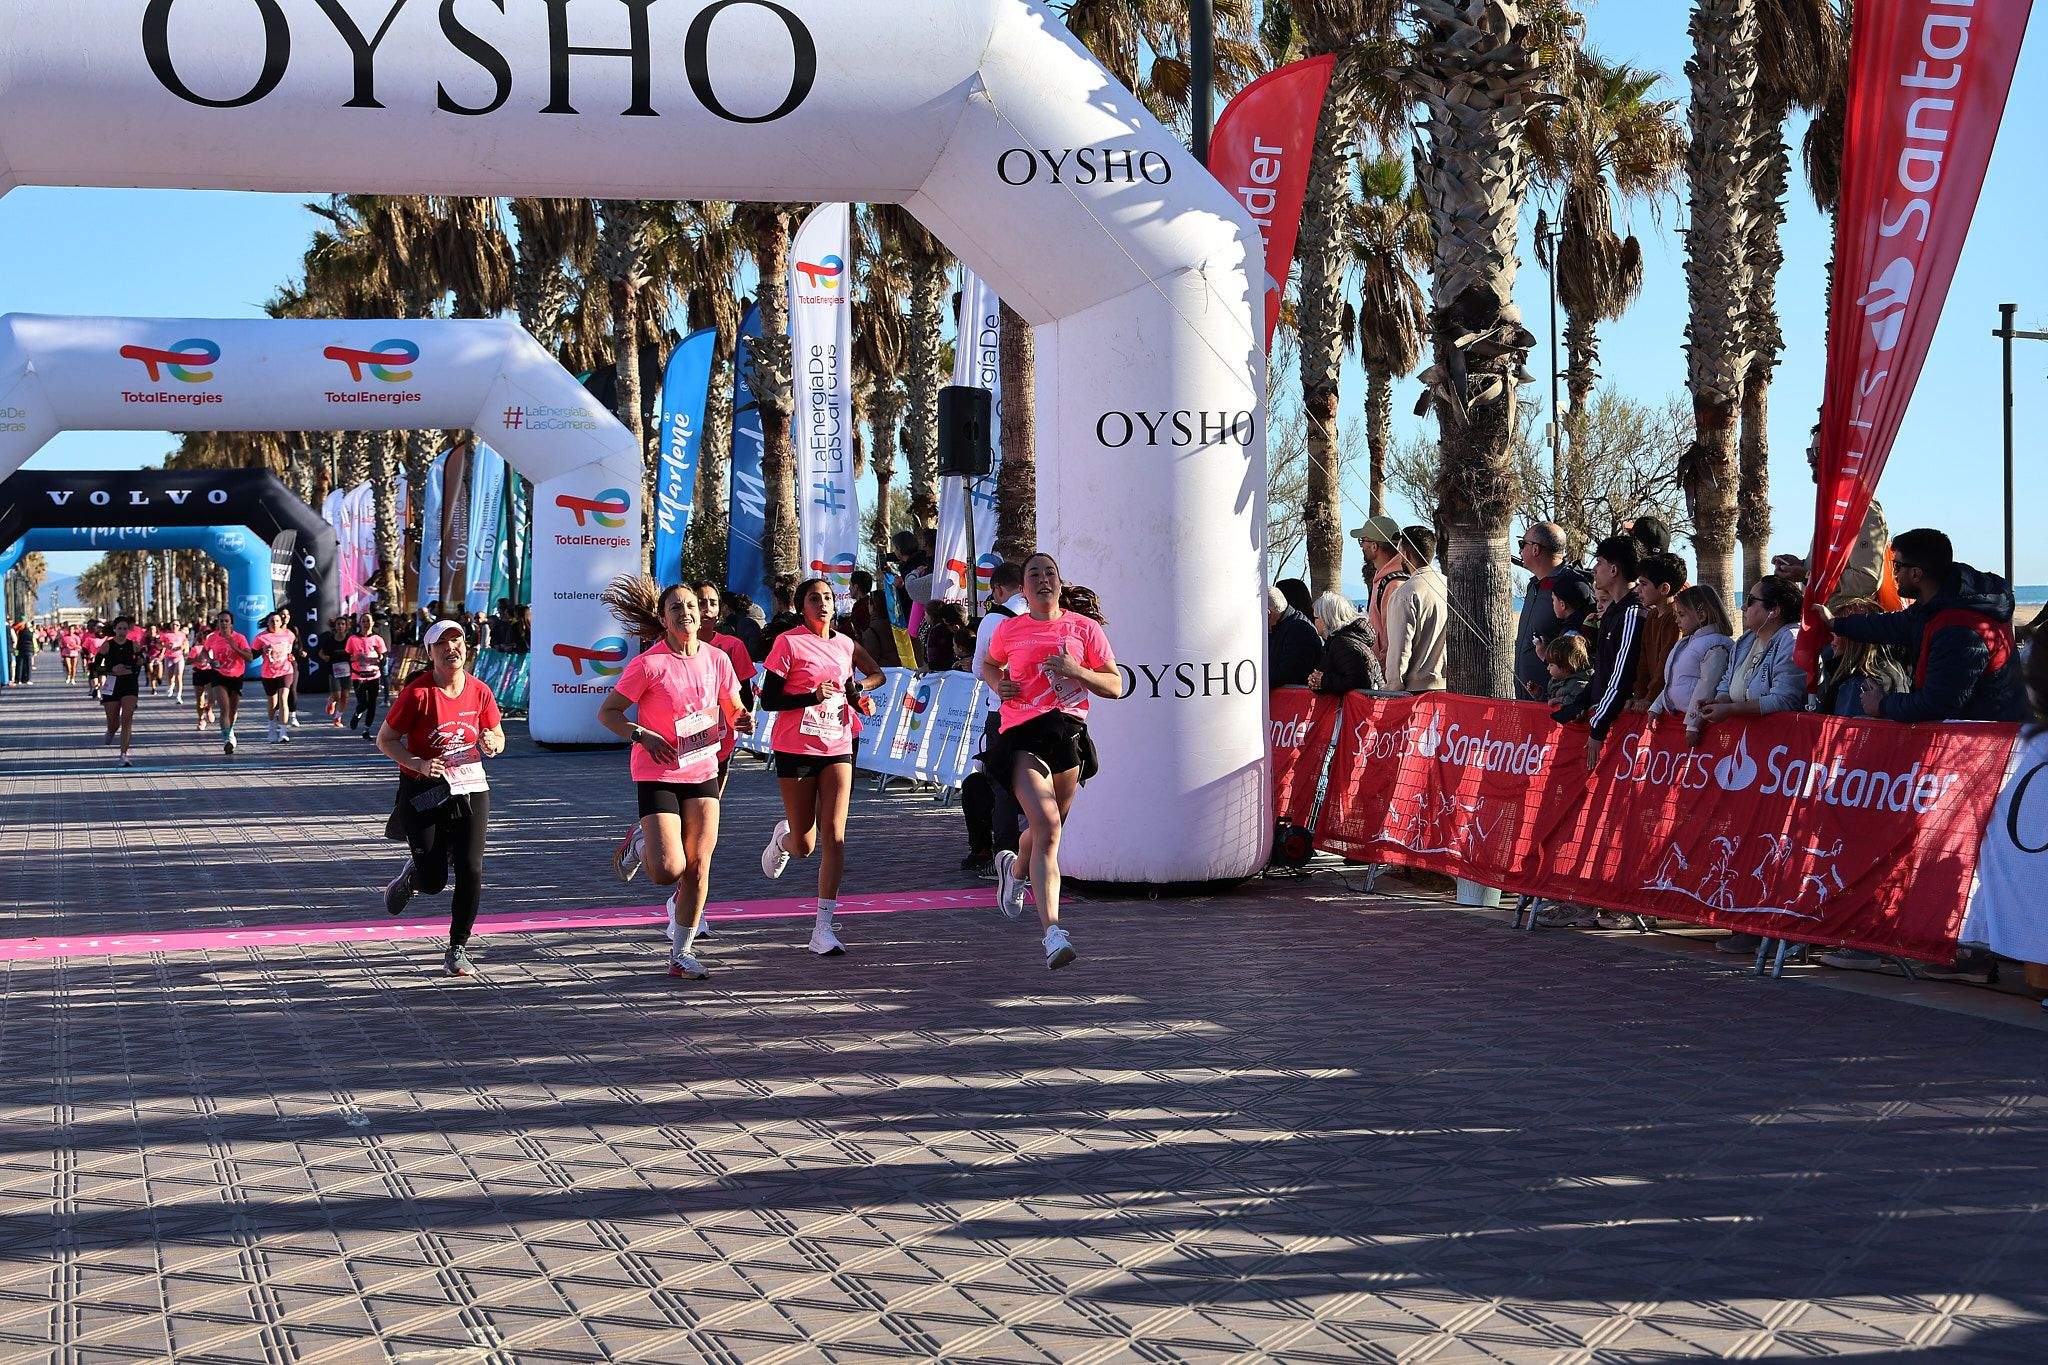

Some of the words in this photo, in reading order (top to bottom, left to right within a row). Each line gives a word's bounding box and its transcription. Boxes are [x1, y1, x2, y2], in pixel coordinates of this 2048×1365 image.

[142, 0, 817, 123] OYSHO
[1879, 0, 1974, 241] Santa
[997, 148, 1172, 186] OYSHO
[799, 295, 845, 306] TotalEnergies
[121, 391, 223, 405] TotalEnergies
[324, 391, 421, 405] TotalEnergies
[1096, 411, 1255, 447] OYSHO
[658, 413, 694, 534] Marlene
[47, 490, 228, 505] VOLVO
[555, 535, 631, 548] TotalEnergies
[304, 555, 317, 675] VOLVO
[1440, 723, 1553, 775] Santander
[1614, 733, 1714, 790] Sports
[1760, 744, 1959, 815] Santander
